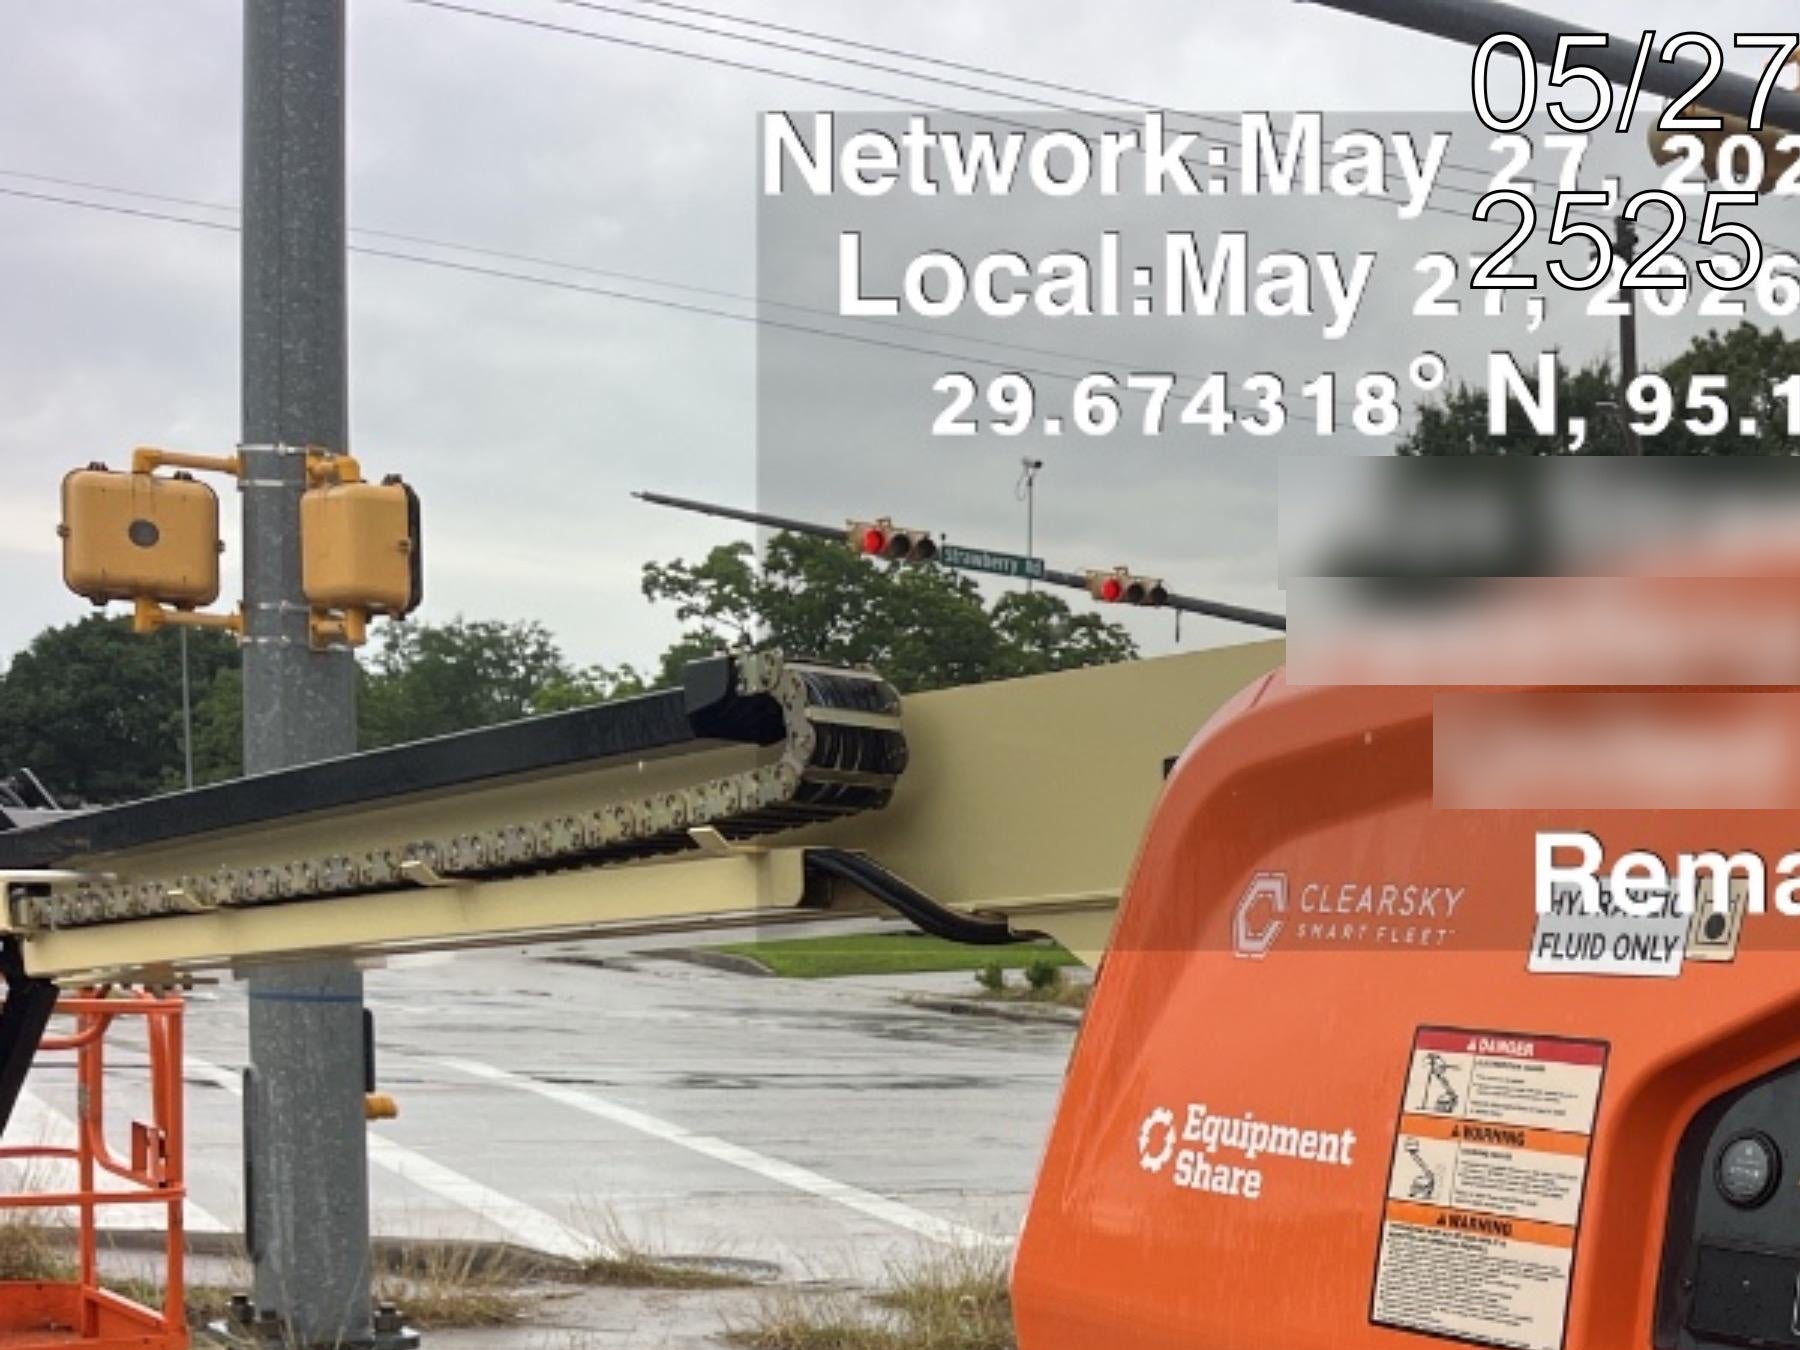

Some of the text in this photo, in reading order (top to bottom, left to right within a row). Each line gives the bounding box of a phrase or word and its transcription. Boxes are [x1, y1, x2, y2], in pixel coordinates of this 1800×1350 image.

[1300, 884, 1465, 917] CLEARSKY
[1297, 922, 1367, 943] SMART
[1538, 931, 1682, 964] FLUID ONLY
[1478, 1038, 1535, 1057] DANGER
[1182, 1103, 1357, 1166] Equipment
[1173, 1148, 1262, 1200] Share
[1448, 1213, 1513, 1237] WARNING
